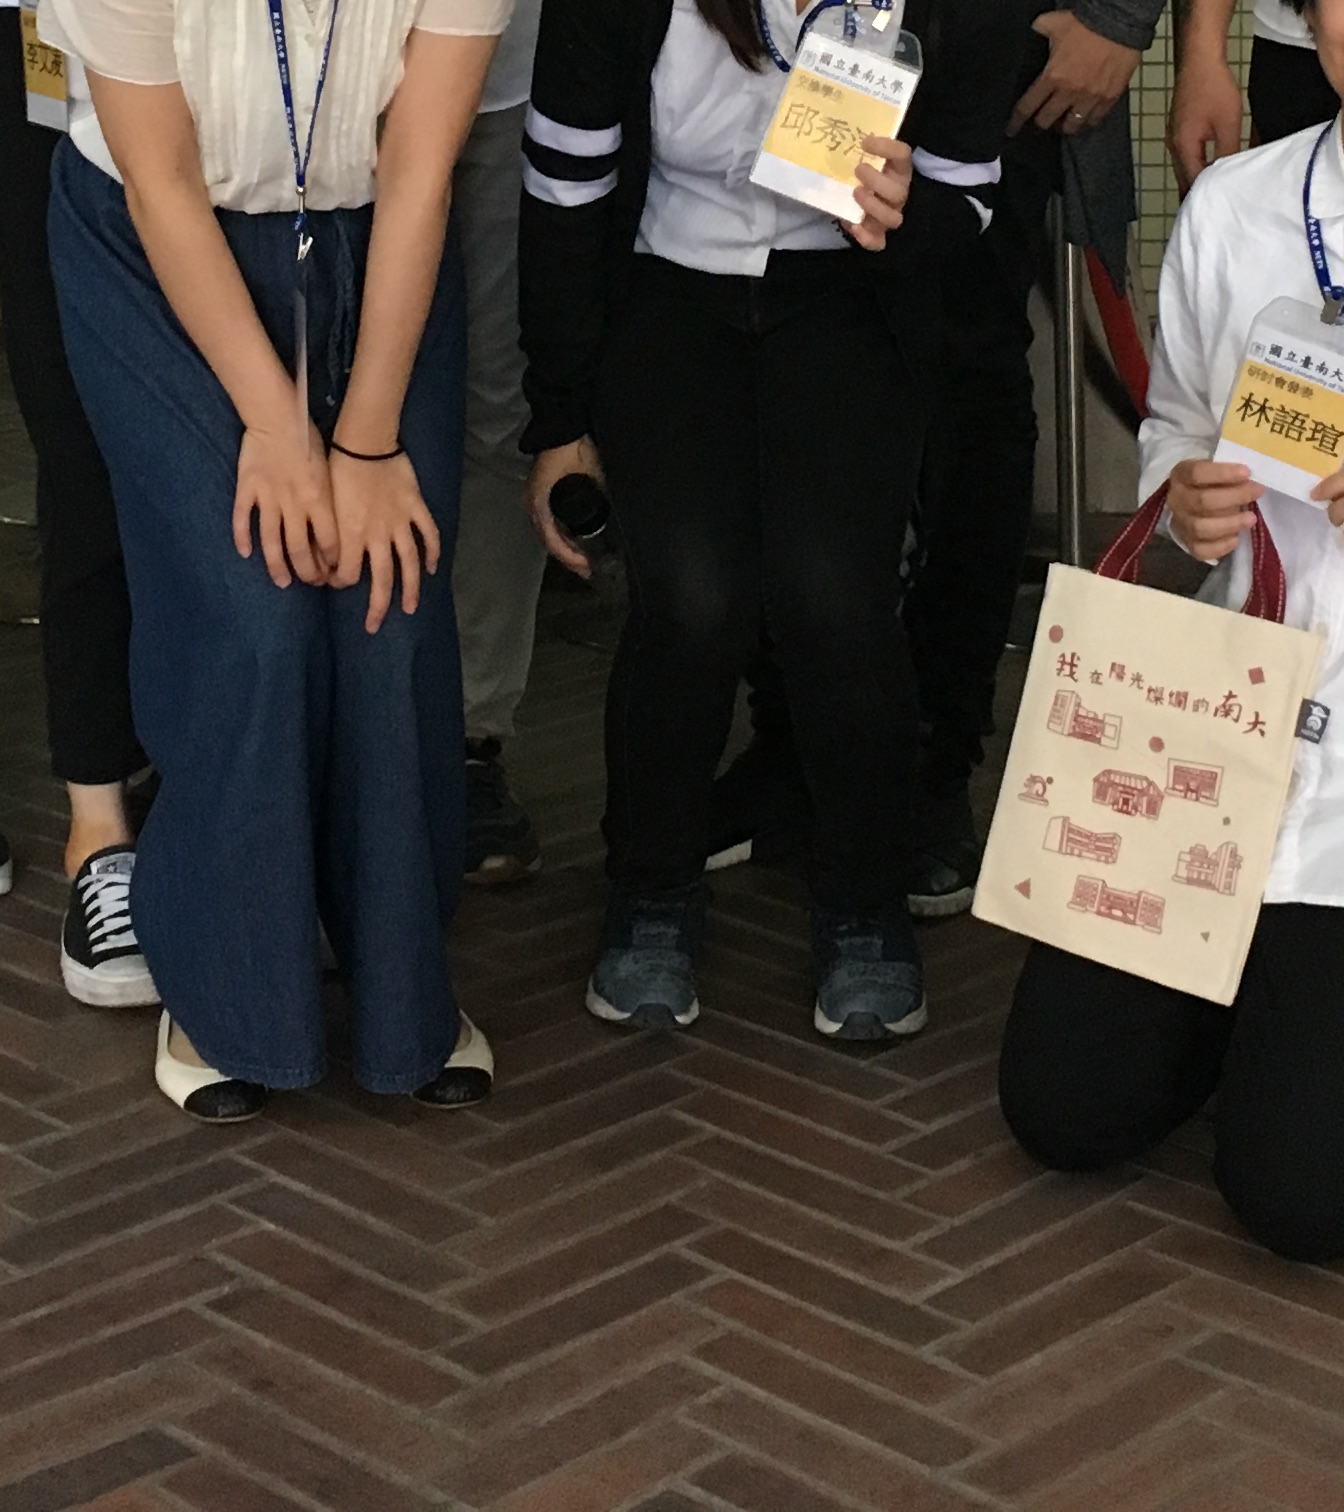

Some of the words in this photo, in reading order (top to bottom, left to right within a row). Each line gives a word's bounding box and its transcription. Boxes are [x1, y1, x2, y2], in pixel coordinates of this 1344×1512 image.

[819, 52, 904, 94] 國立臺南大學
